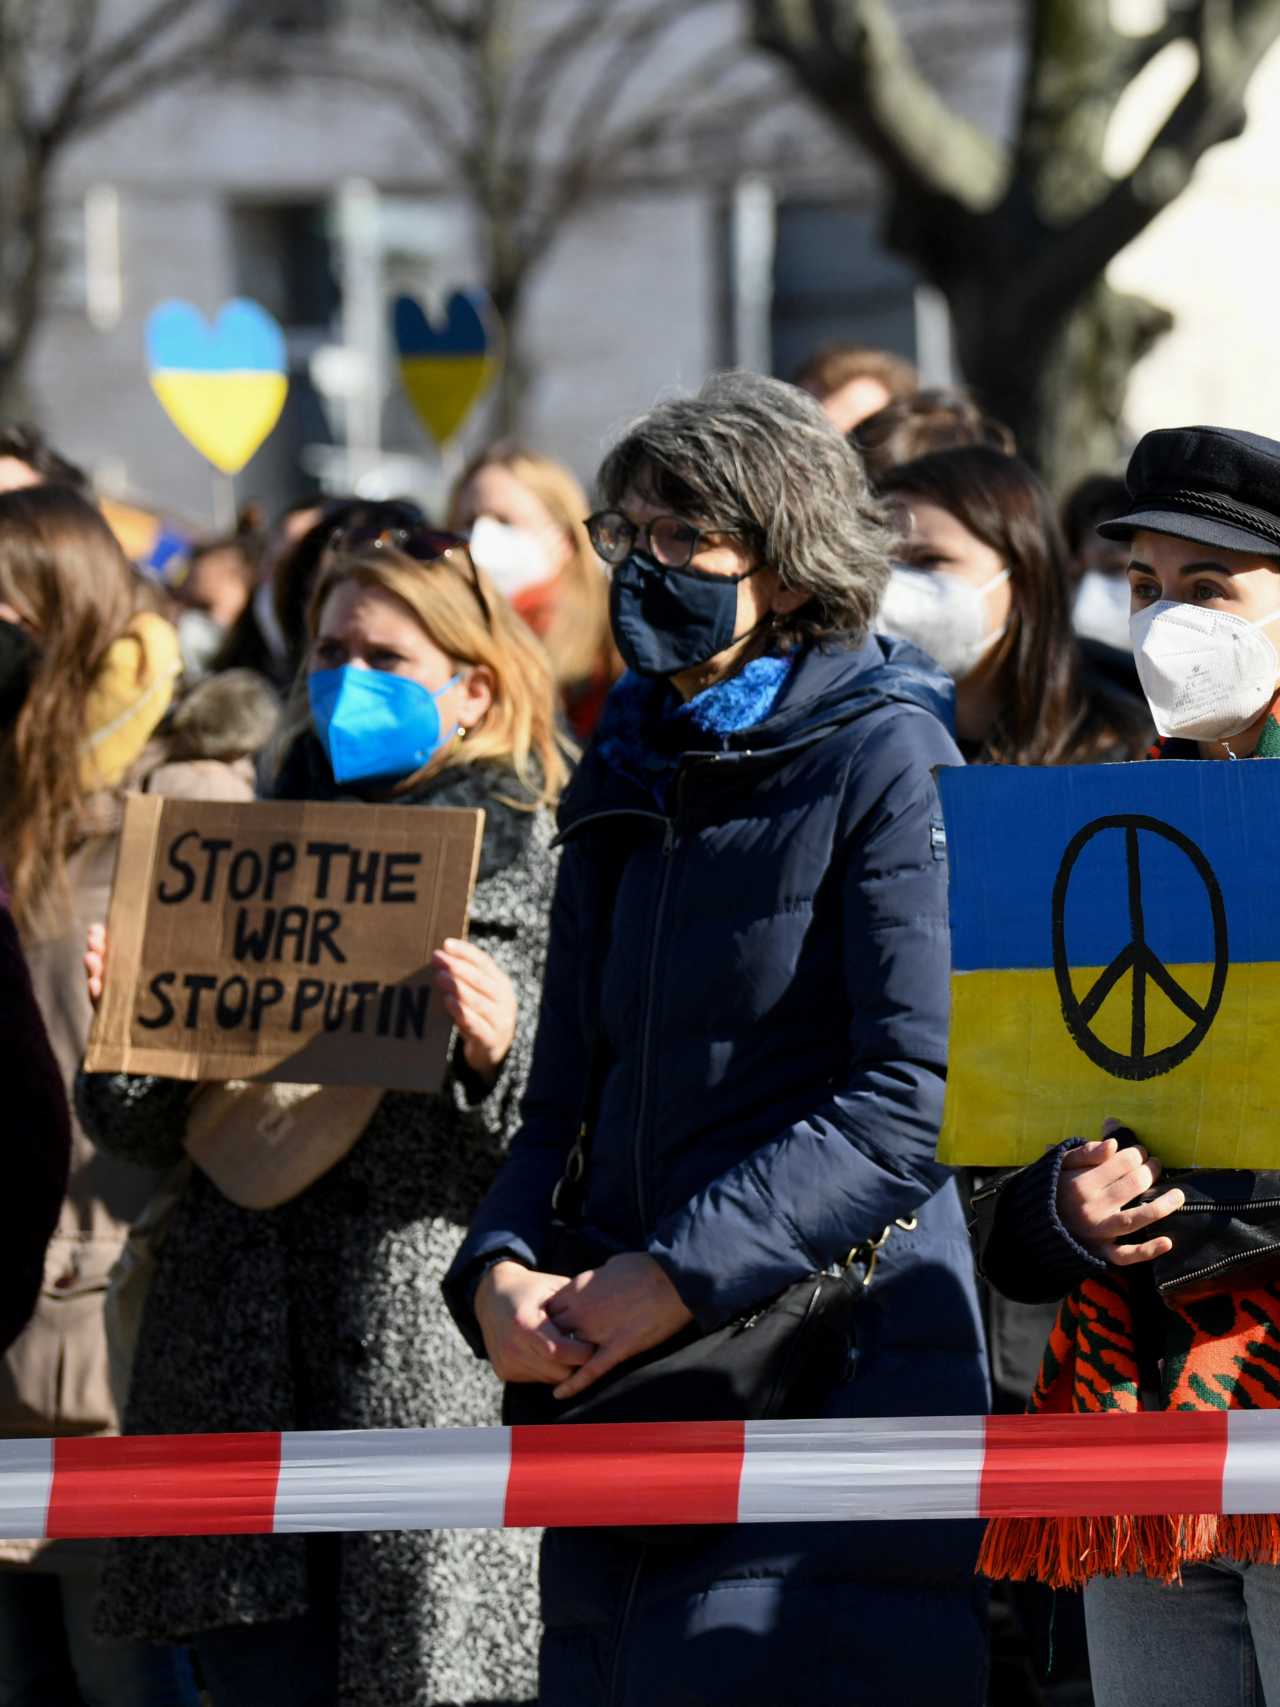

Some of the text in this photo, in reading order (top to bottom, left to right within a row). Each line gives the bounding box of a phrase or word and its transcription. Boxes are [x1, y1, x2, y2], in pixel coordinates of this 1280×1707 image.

[158, 831, 422, 904] STOP THE
[233, 906, 347, 965] WAR
[138, 971, 432, 1040] STOP PUTIN
